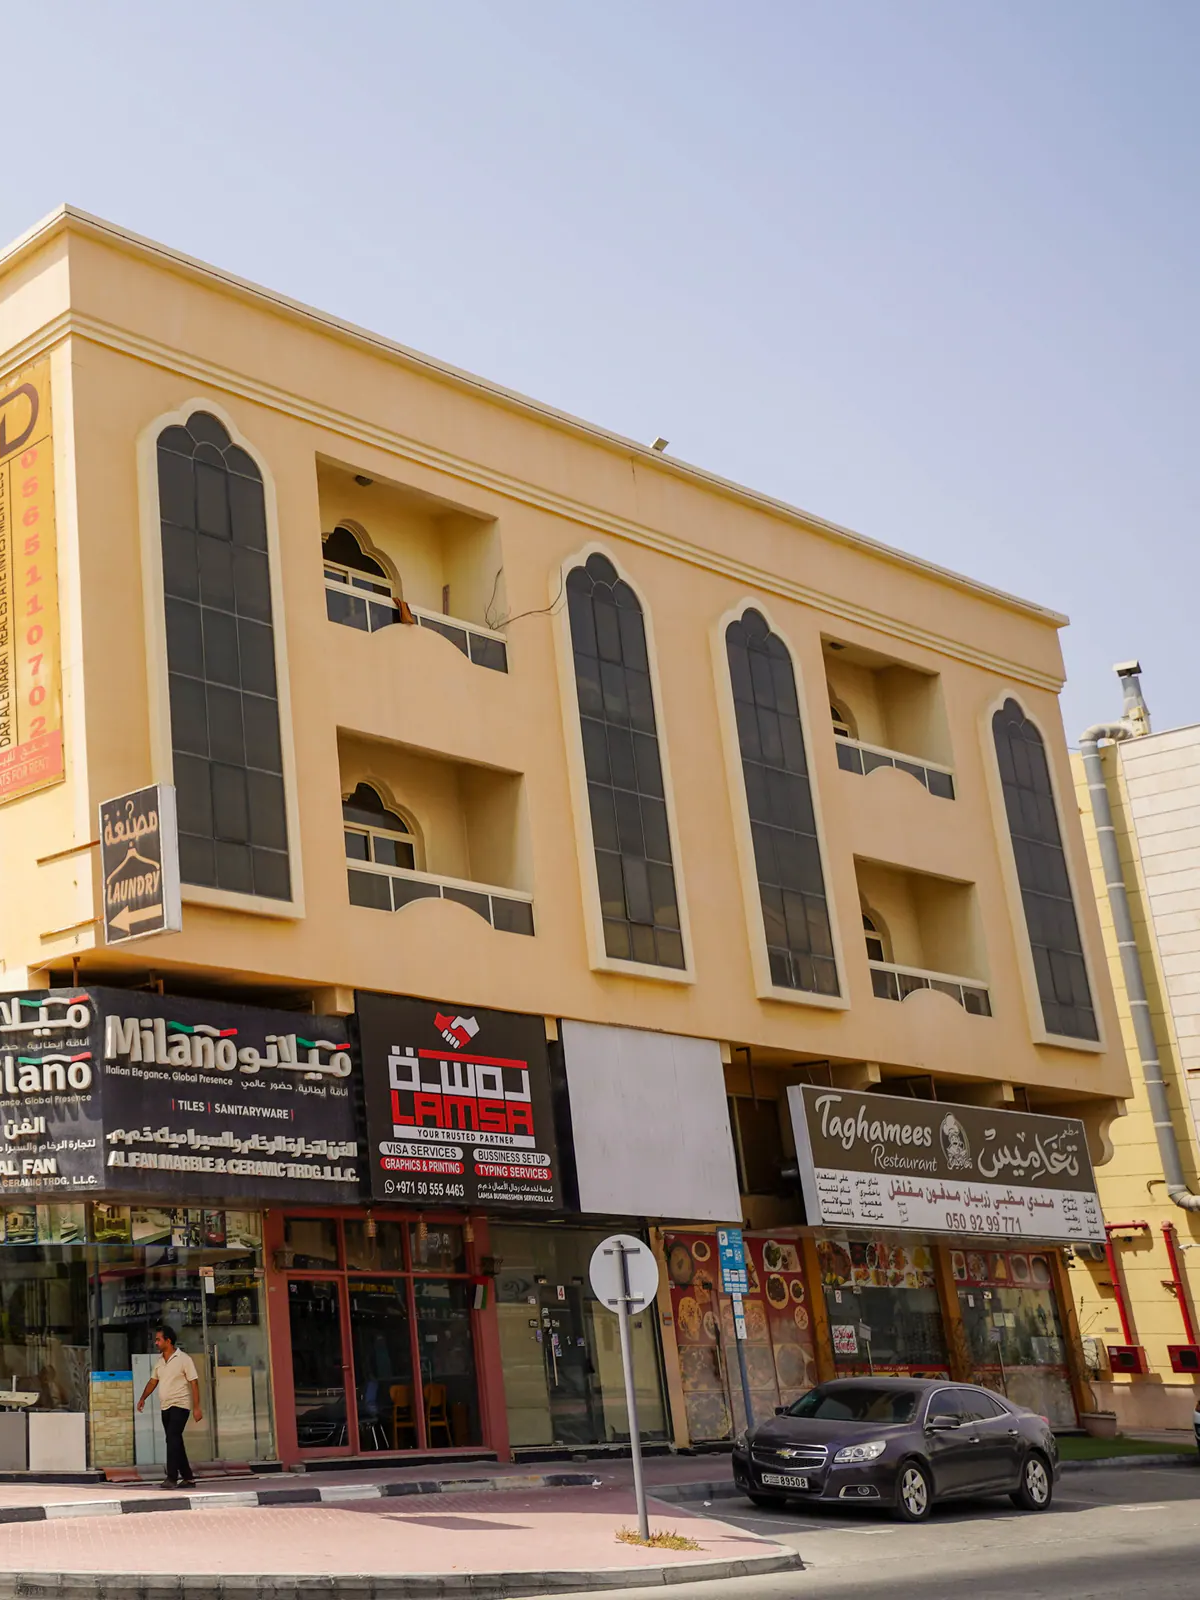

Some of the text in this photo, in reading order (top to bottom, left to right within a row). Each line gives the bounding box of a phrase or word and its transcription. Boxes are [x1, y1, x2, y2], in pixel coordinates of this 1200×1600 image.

[0, 719, 11, 748] DAR
[12, 764, 28, 782] FOR
[107, 870, 160, 905] LAUNDRY
[104, 1015, 238, 1071] Milano
[238, 1033, 352, 1080] ميلانو
[105, 1064, 130, 1076] Italian
[172, 1070, 198, 1083] Global
[199, 1074, 233, 1086] Presence
[241, 1079, 266, 1090] عالمي
[270, 1081, 293, 1092] حضور
[25, 1097, 53, 1105] Global
[54, 1094, 92, 1103] Presence
[178, 1100, 289, 1119] TILES SANITARYWARE
[390, 1090, 534, 1135] LAMSA
[4, 1116, 46, 1140] الفن
[815, 1095, 932, 1150] Taghamees
[68, 1139, 96, 1150] لتجارة
[417, 1129, 514, 1145] YOUR TRUSTED PARTNER
[38, 1141, 68, 1152] الرخام
[326, 1141, 358, 1160] الفن
[386, 1143, 457, 1158] VISA SERVICES
[107, 1151, 129, 1167] AL
[128, 1152, 158, 1168] FAN
[158, 1154, 215, 1172] MARBLE
[215, 1158, 227, 1173] &
[227, 1158, 286, 1177] CERAMIC
[385, 1158, 460, 1173] GRAPHICS & PRINTING
[478, 1150, 546, 1164] BUSSINESS SETUP
[870, 1143, 938, 1172] Restaurant
[22, 1158, 57, 1175] FAN
[479, 1165, 548, 1179] TYPING SERVICES
[2, 1178, 42, 1187] CERAMIC
[396, 1181, 464, 1197] +971 50 555 4463
[524, 1194, 543, 1202] SERVICES
[926, 1183, 961, 1204] مدفون
[1027, 1194, 1054, 1217] مندي
[946, 1212, 1022, 1233] 050 92 99 771
[763, 1474, 769, 1483] C
[779, 1476, 806, 1488] 89508
